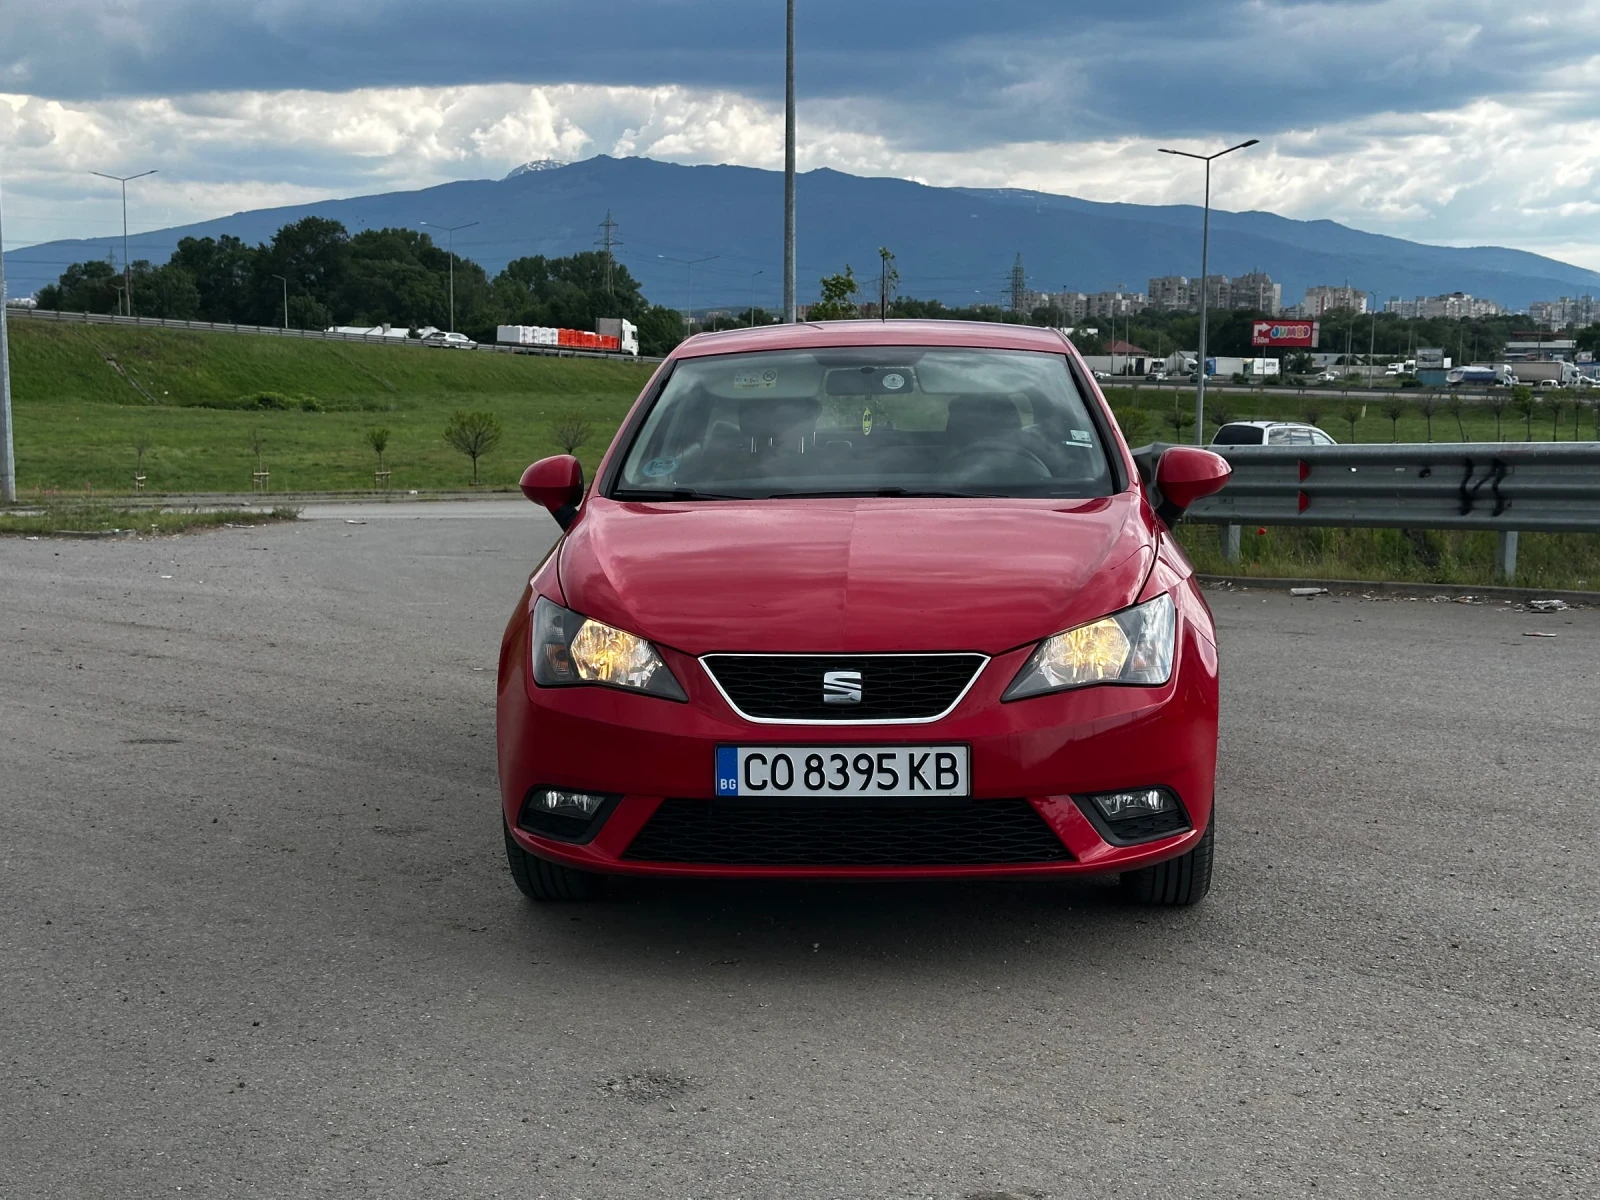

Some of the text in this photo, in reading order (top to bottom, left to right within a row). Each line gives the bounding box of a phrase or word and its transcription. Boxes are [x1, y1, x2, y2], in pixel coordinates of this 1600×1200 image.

[1270, 325, 1311, 338] JUMBO
[744, 753, 960, 791] CO 8395 KB
[720, 778, 737, 790] BG
